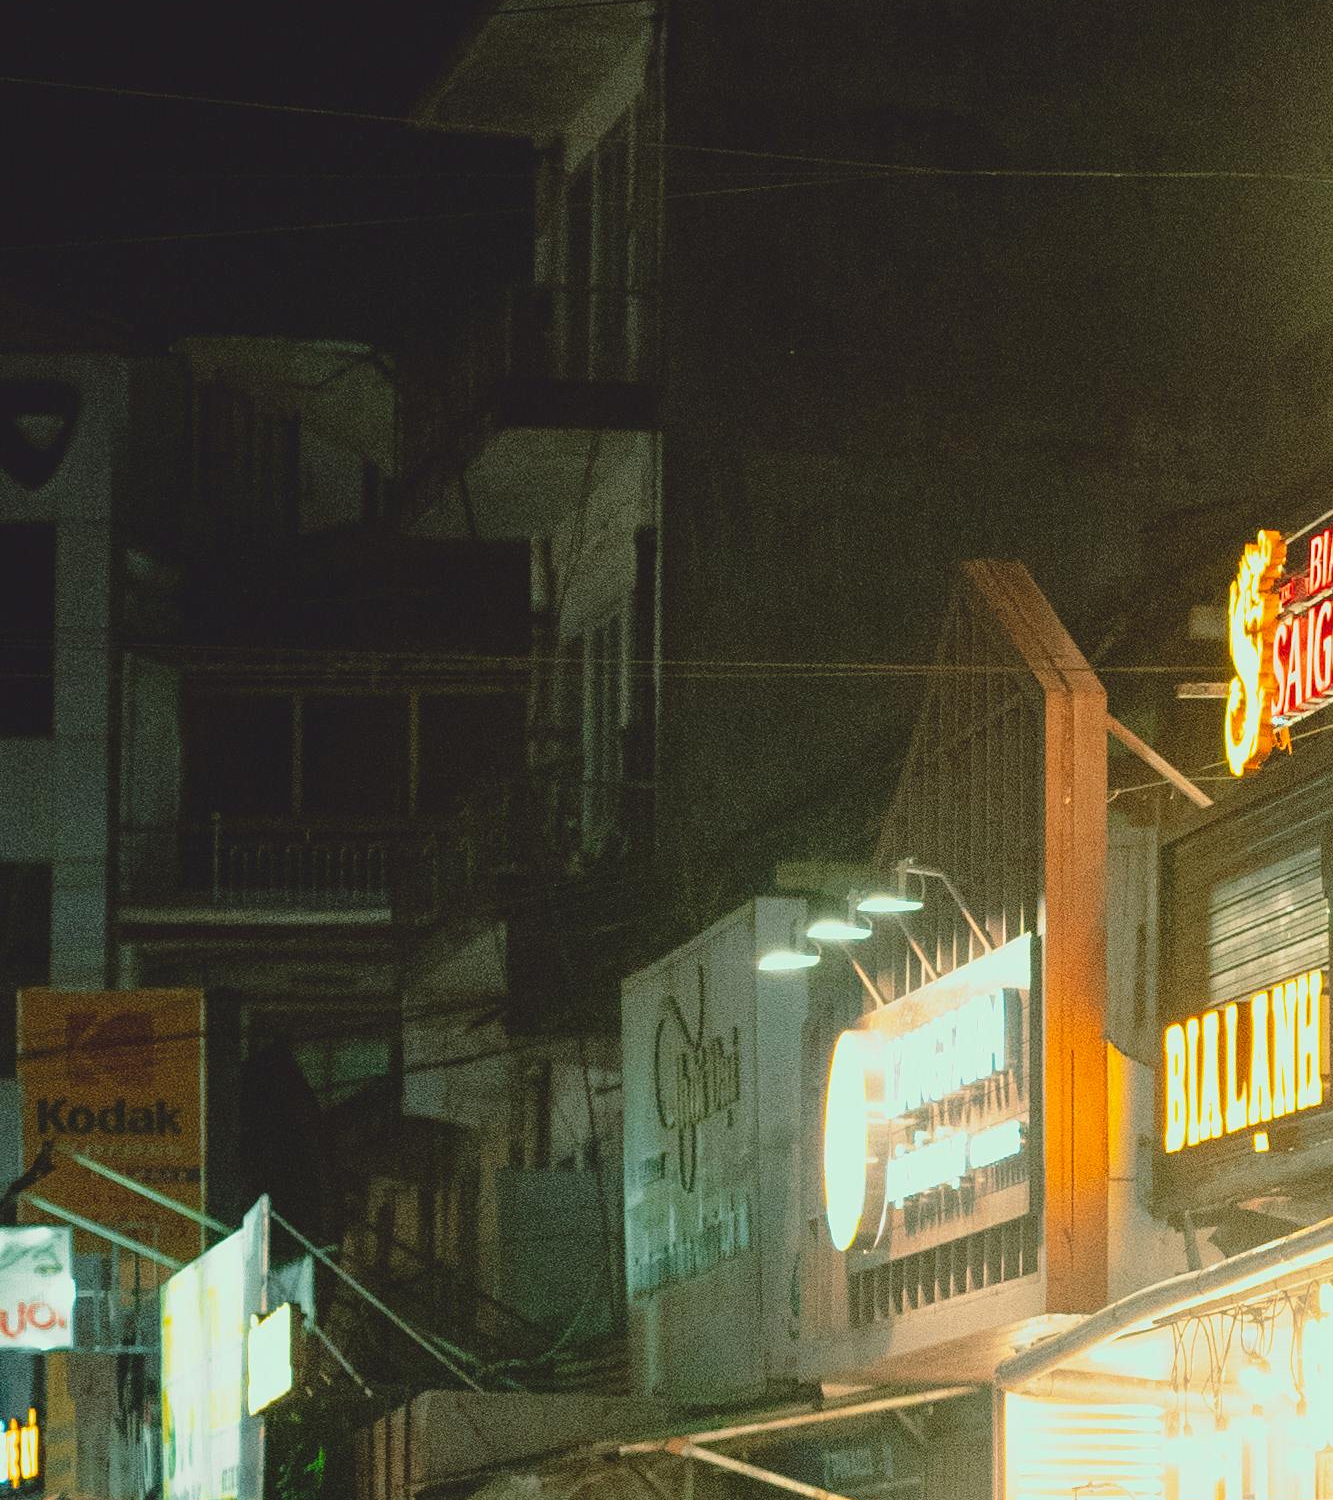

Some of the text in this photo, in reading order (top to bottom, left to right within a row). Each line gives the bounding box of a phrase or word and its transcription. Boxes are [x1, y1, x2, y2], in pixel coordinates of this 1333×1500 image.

[36, 1097, 184, 1137] Kodak
[1164, 1008, 1223, 1154] BIA
[1225, 969, 1324, 1153] LẠNH
